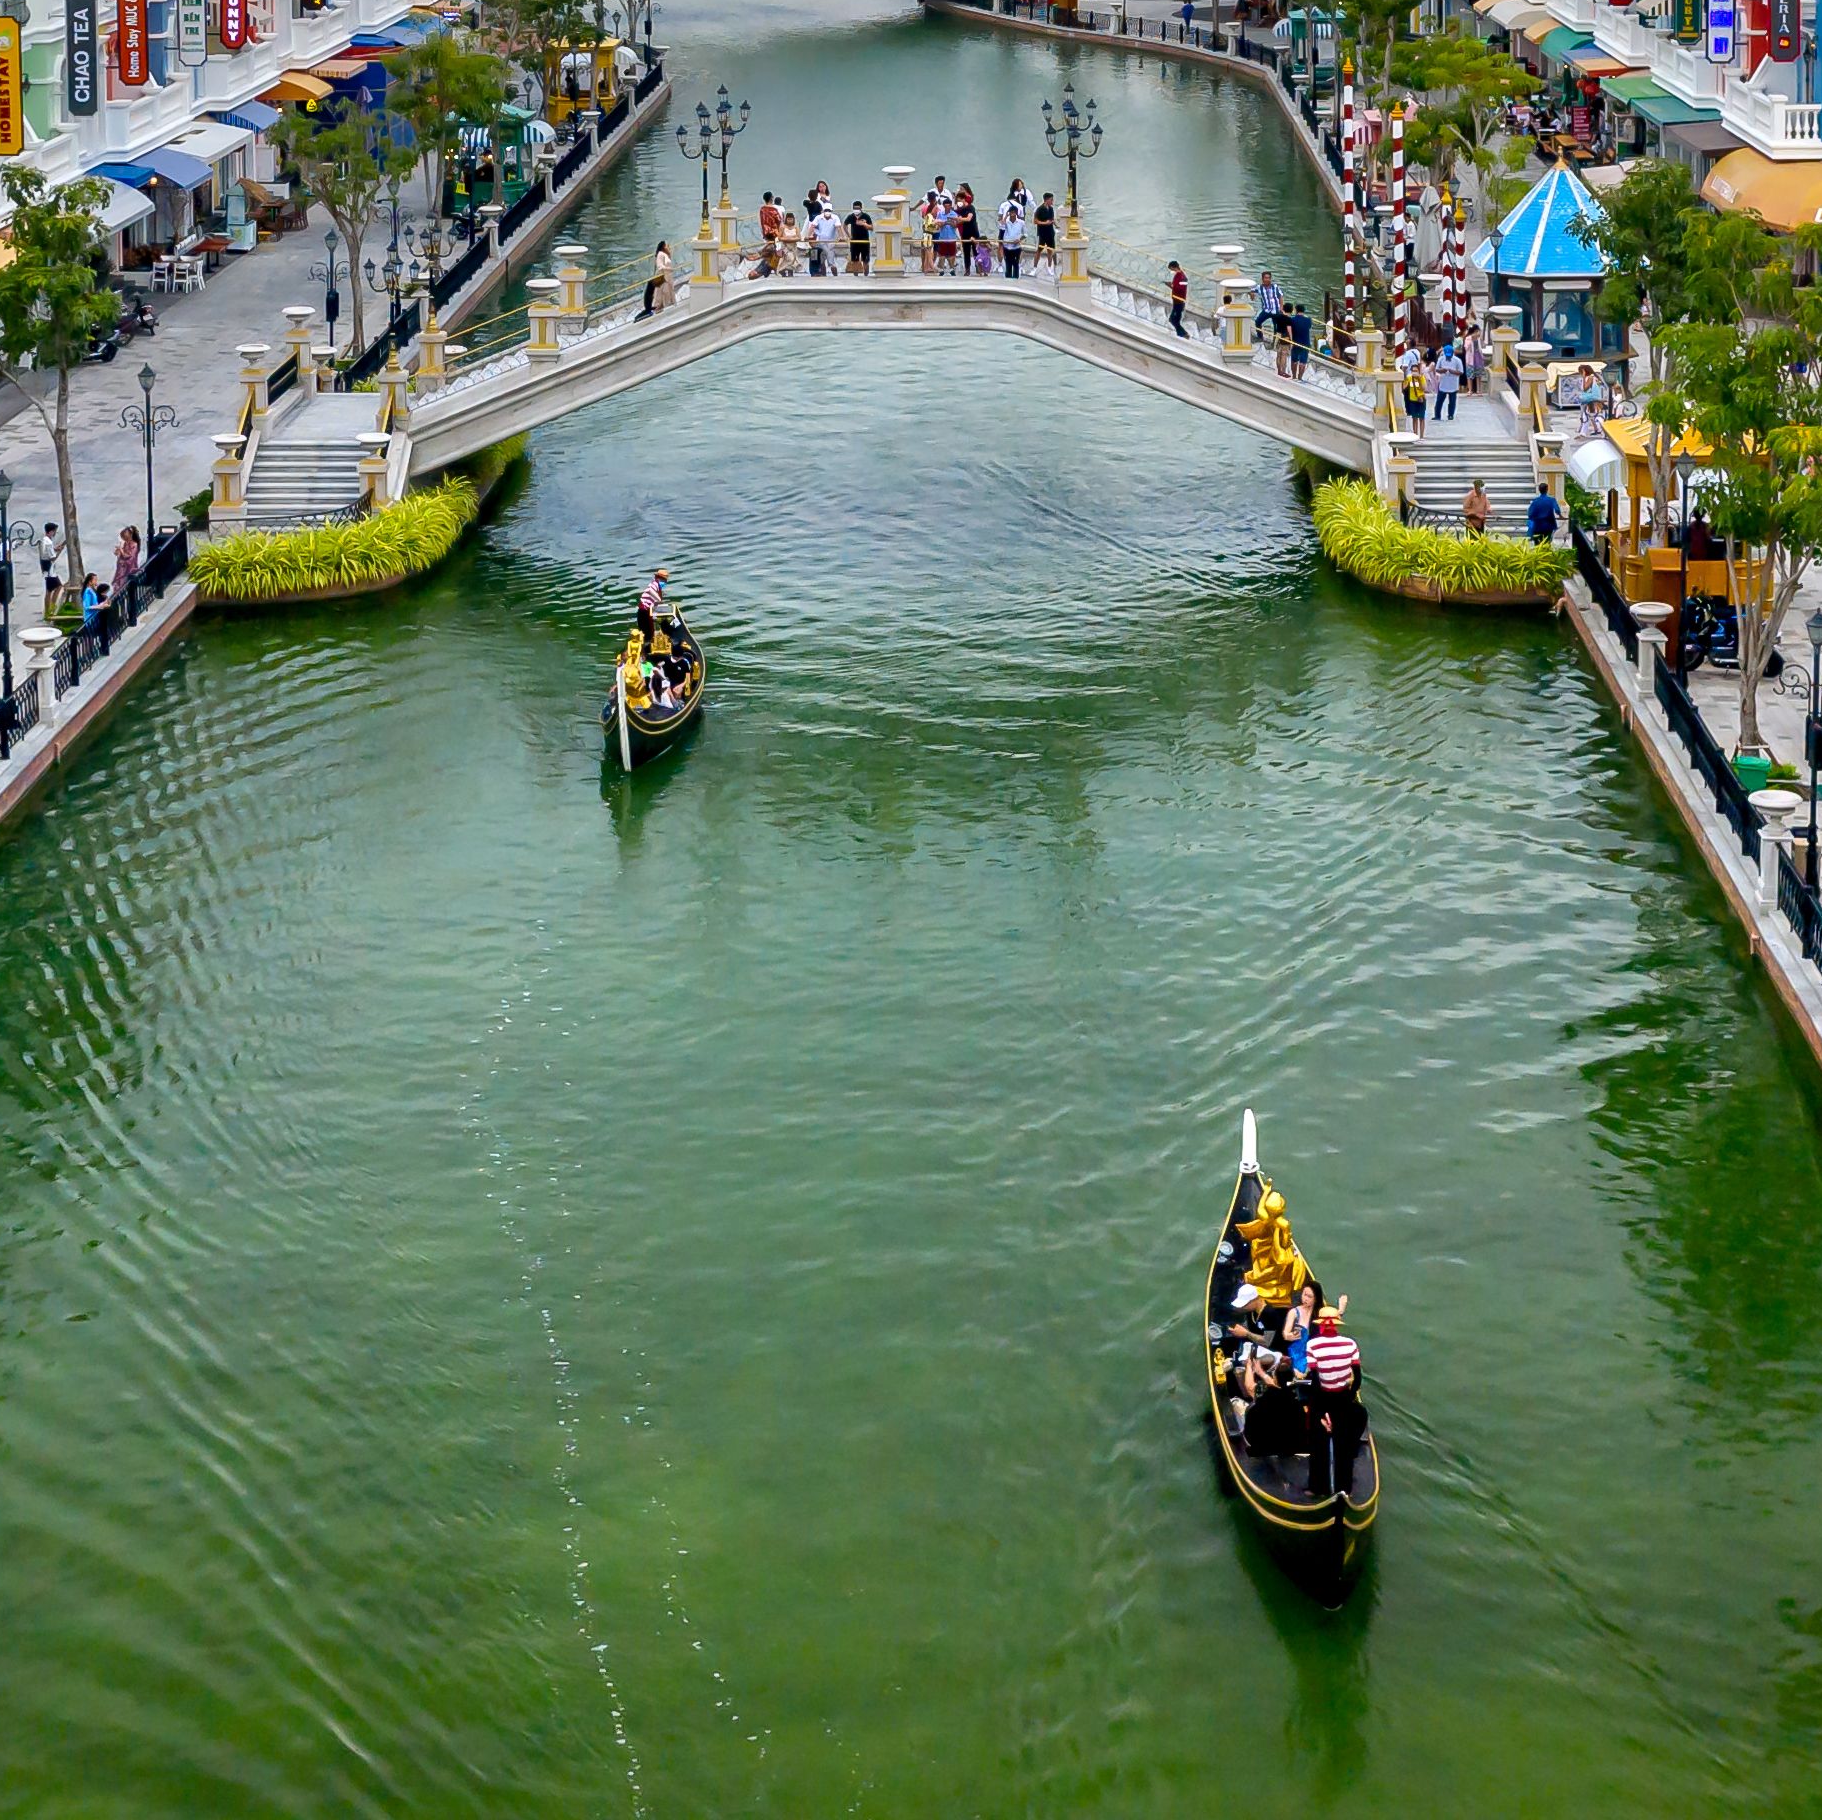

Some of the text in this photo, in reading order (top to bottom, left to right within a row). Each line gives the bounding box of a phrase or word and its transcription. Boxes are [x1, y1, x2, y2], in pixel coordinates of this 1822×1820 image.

[125, 4, 138, 27] MUC
[73, 7, 90, 103] CHAO TEA
